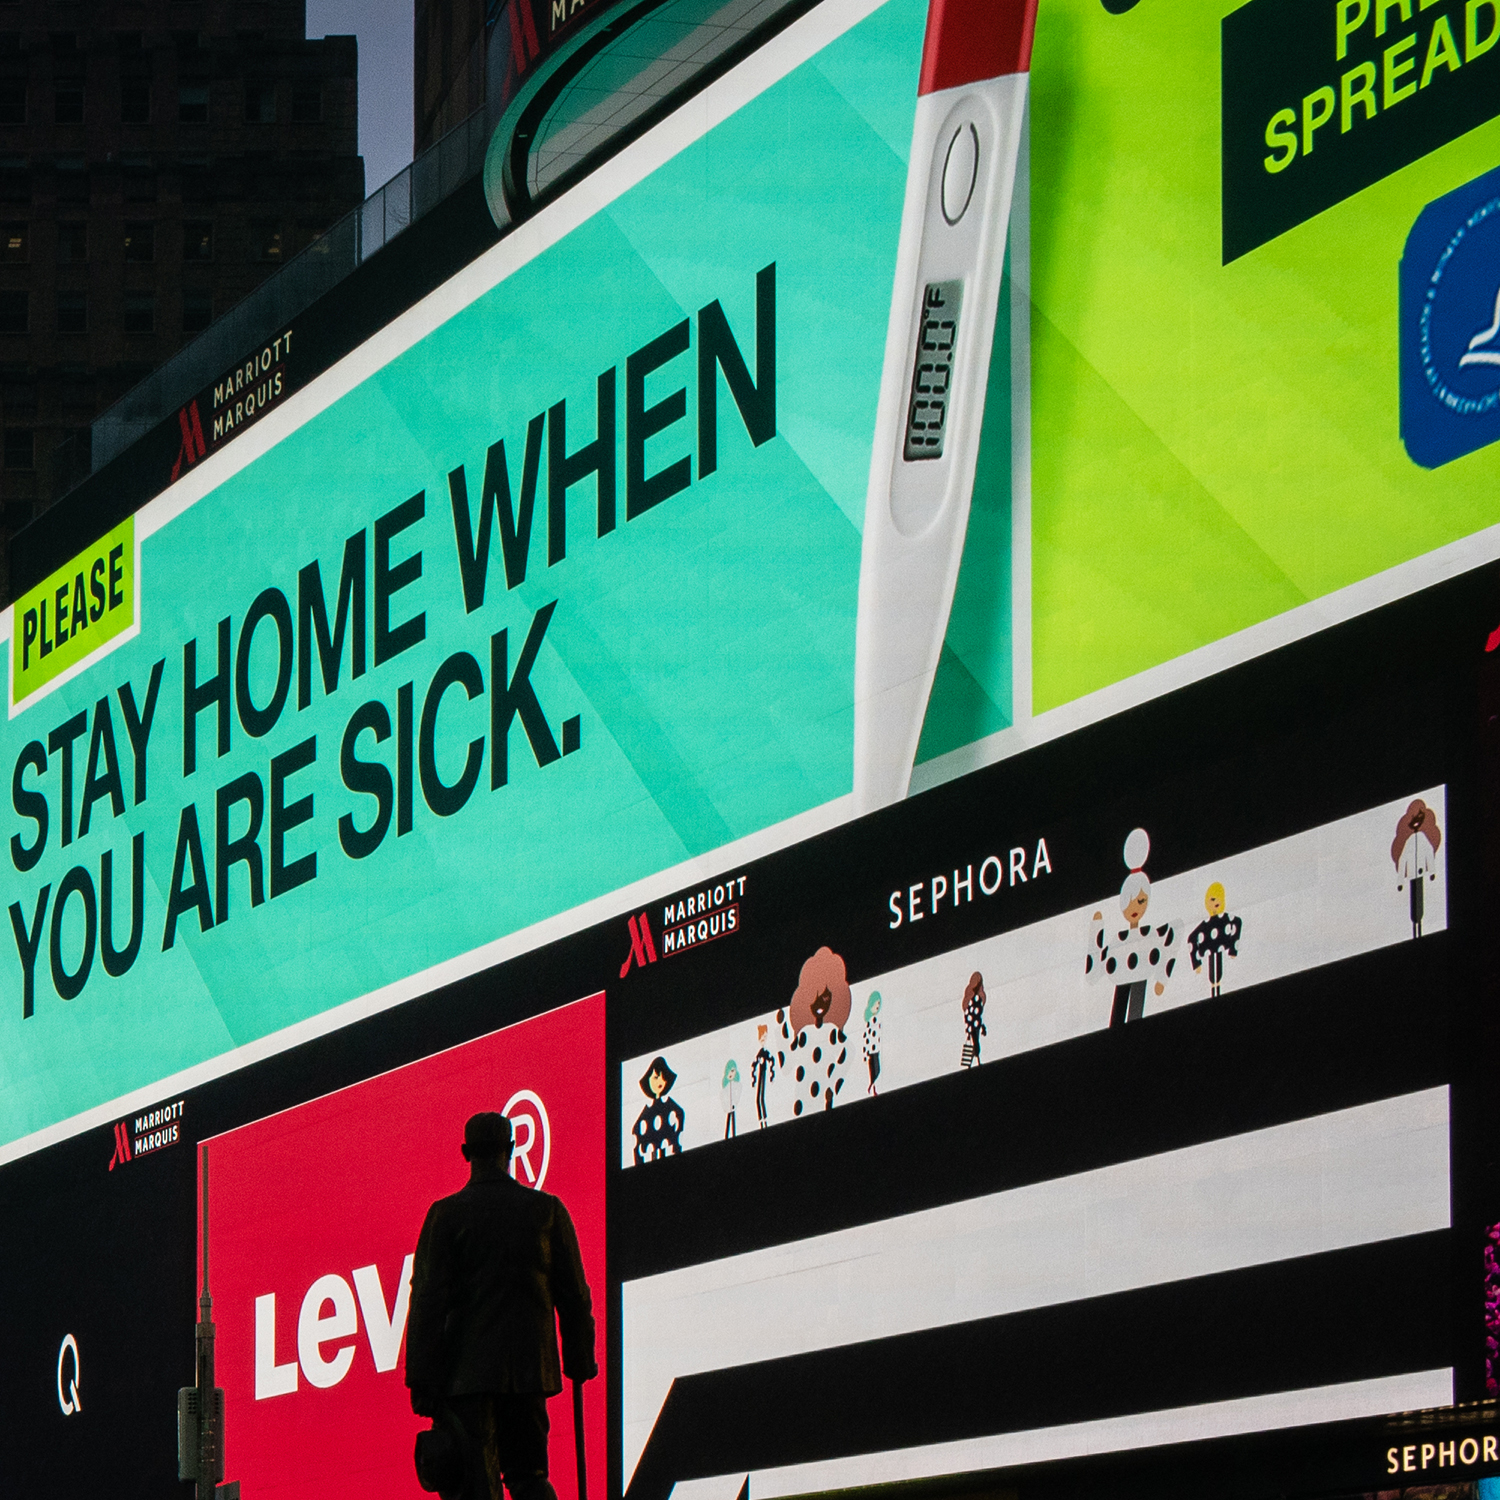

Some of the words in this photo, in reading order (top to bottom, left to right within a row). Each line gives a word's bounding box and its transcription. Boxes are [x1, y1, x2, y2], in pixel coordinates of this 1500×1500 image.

[212, 370, 285, 442] MARQUIS
[213, 331, 294, 407] MARRIOTT
[8, 655, 167, 873] STAY
[183, 490, 427, 780] HOME
[448, 260, 778, 615] WHEN
[21, 542, 125, 672] PLEASE
[8, 830, 146, 1021] YOU
[160, 735, 319, 954] ARE
[336, 598, 582, 862] SICK.
[663, 875, 748, 926] MARRIOTT
[887, 836, 1054, 931] SEPHORA
[662, 907, 739, 957] MARQUIS
[133, 1100, 186, 1133] MARRIOTT
[133, 1124, 180, 1157] MARQUIS
[56, 1332, 82, 1417] Q
